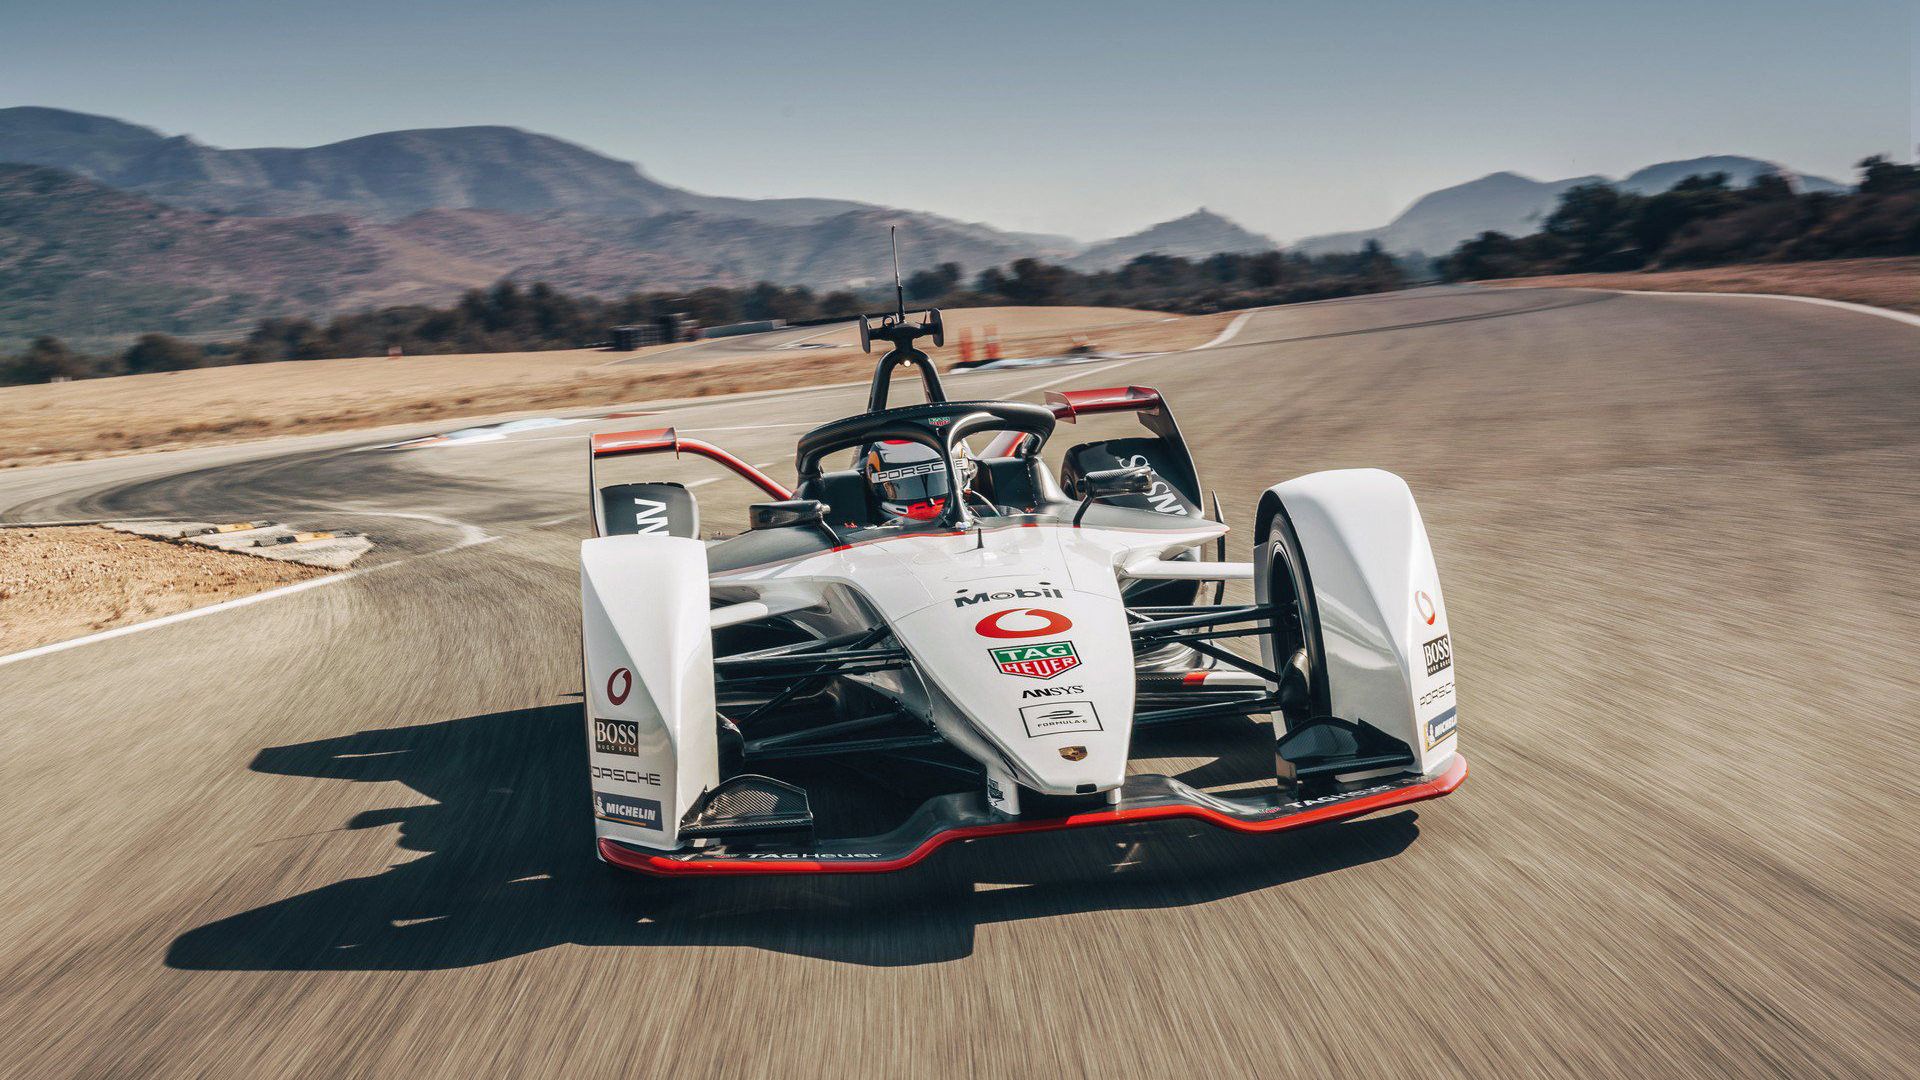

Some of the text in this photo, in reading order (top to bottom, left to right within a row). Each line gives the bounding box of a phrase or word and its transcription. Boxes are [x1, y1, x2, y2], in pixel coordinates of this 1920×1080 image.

[878, 460, 963, 480] PORSCE
[954, 582, 1063, 608] Mobil
[999, 645, 1065, 661] TAG
[1424, 638, 1449, 666] BOSS
[1001, 657, 1074, 676] HEUER
[1022, 685, 1084, 698] ANSYS
[1420, 682, 1455, 706] PORSC
[596, 722, 636, 745] BOSS
[592, 766, 661, 786] ORSCHE
[606, 802, 656, 821] MICHELIN
